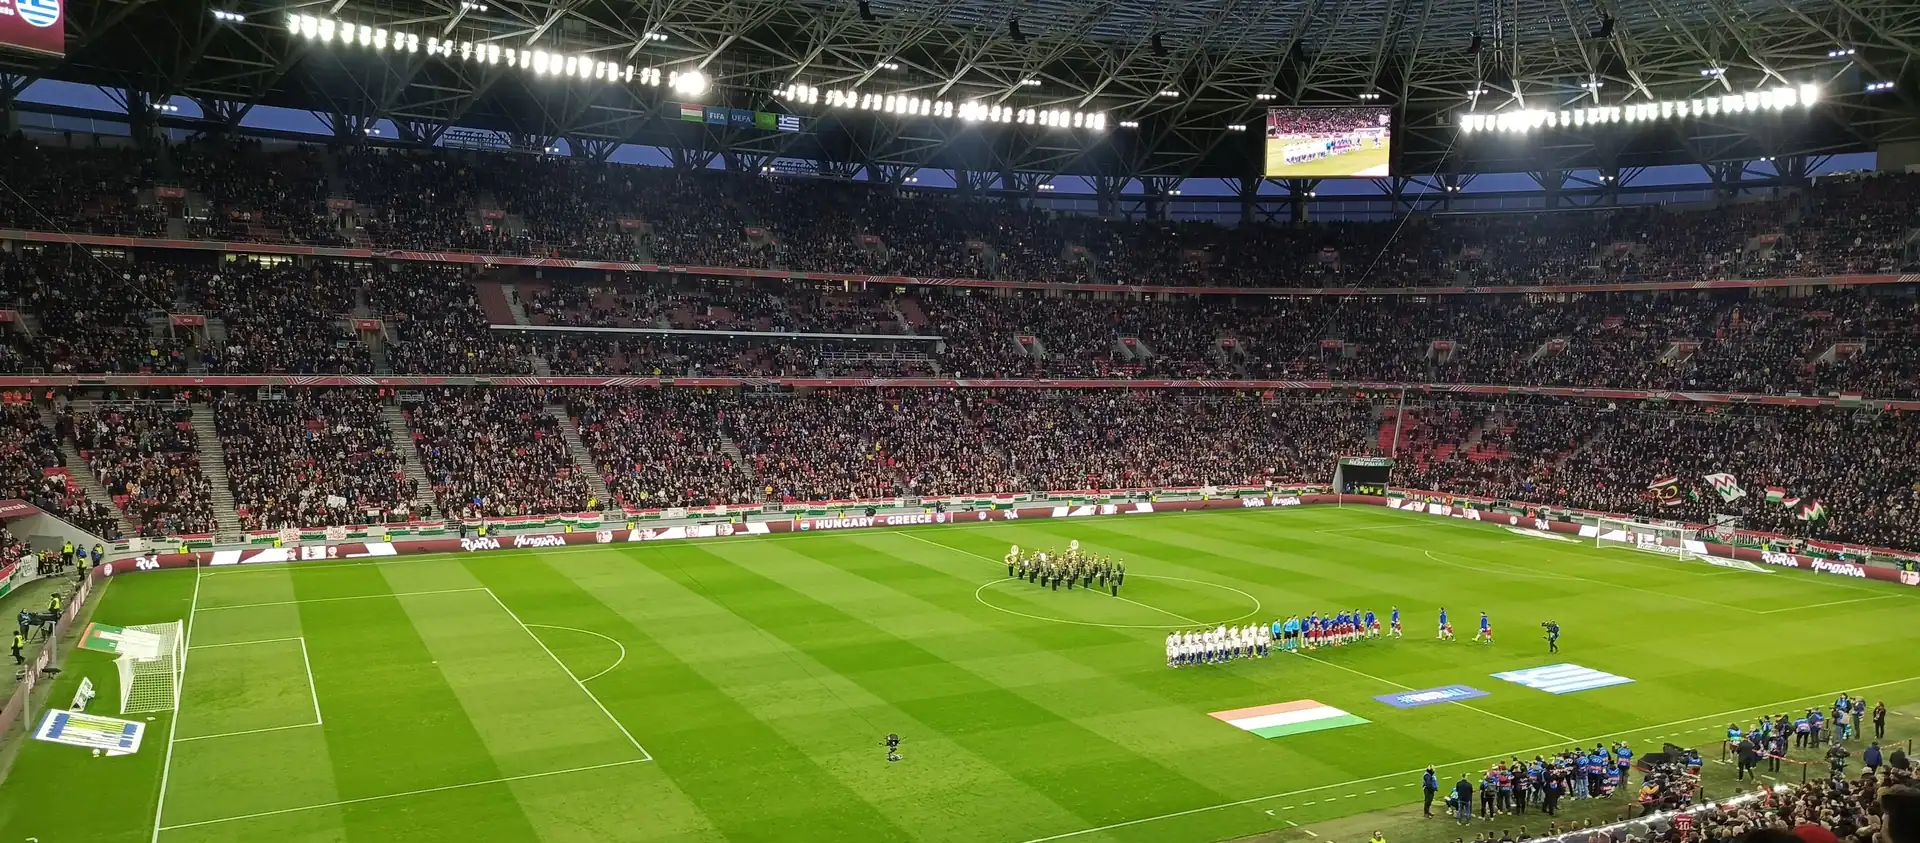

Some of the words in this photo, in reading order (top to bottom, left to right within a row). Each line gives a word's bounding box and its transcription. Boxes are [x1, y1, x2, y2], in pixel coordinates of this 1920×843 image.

[709, 112, 725, 120] FIFA
[731, 113, 751, 122] UEFA
[815, 517, 874, 530] HUNGARY
[887, 515, 932, 526] GREECE
